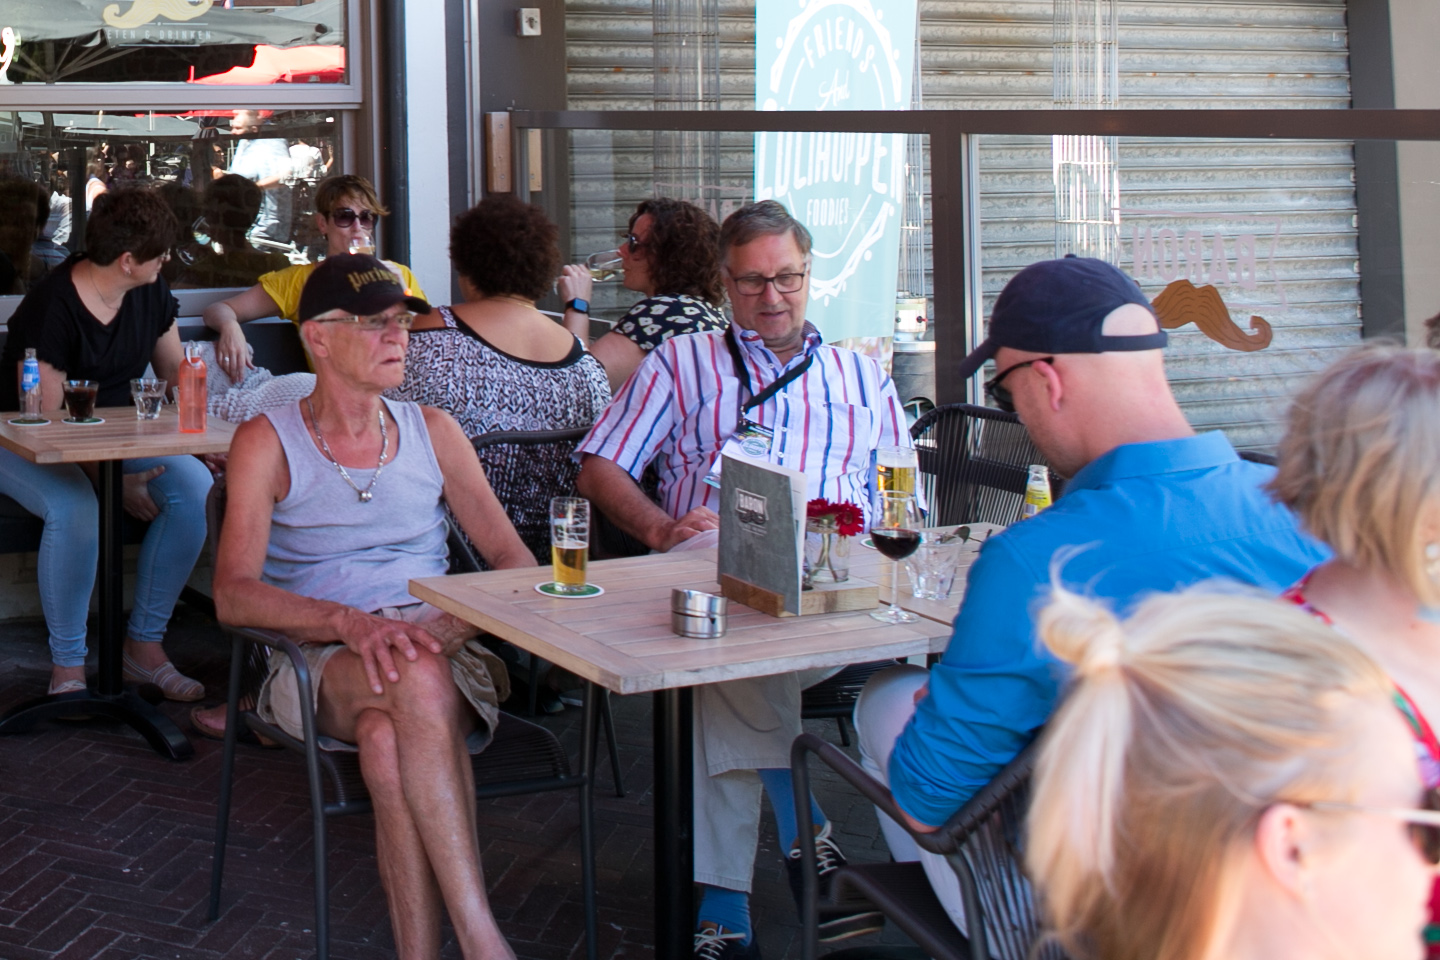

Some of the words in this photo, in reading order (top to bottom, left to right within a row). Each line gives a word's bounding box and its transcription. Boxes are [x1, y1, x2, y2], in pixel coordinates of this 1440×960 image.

[107, 29, 136, 39] ETEN
[145, 30, 151, 39] &
[160, 30, 211, 40] DRINKEN
[803, 16, 876, 73] FRIENDS
[816, 69, 850, 110] And
[806, 197, 850, 227] FOODIES
